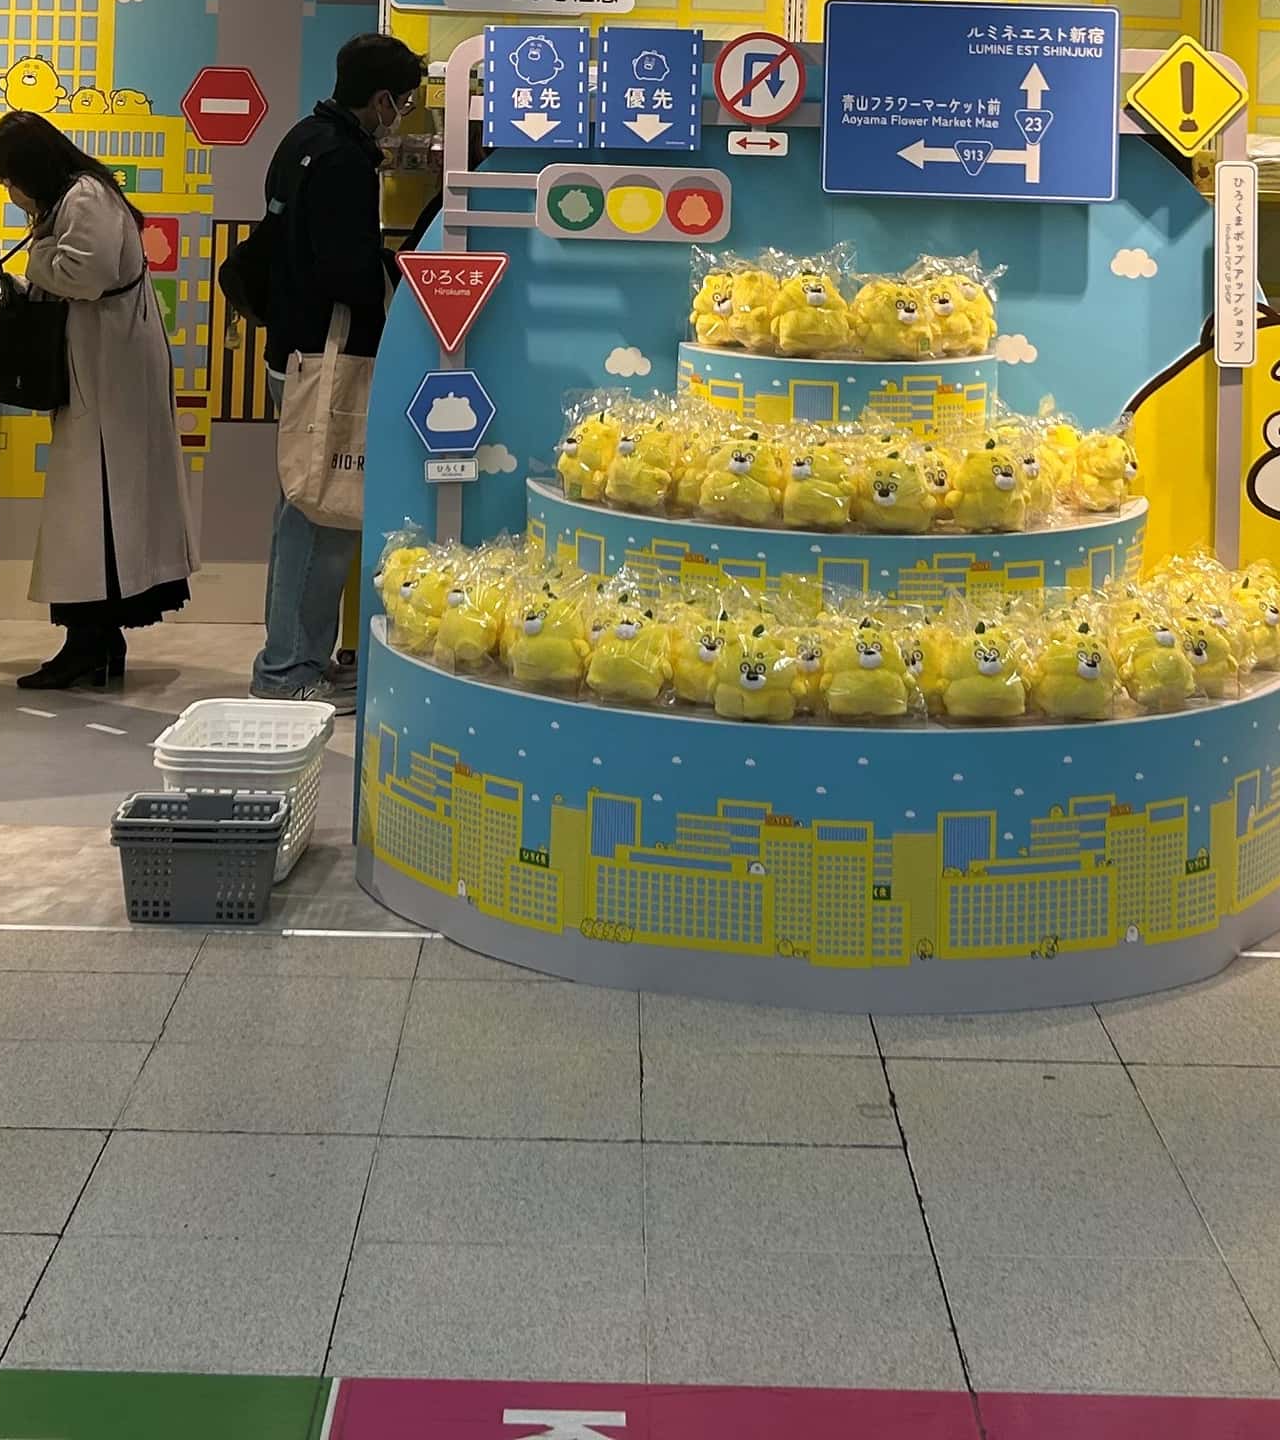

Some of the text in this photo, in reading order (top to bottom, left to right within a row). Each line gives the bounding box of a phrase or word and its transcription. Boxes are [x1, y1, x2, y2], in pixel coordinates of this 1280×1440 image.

[967, 25, 1105, 44] ルミネエスト新宿
[969, 44, 1102, 58] LUMINE EST SHINJUKU
[511, 88, 561, 109] 優先
[624, 88, 673, 110] 優先
[841, 94, 1001, 116] 青山フラワーマーケット前
[841, 113, 999, 128] Aoyama Flower Market Mae
[1025, 117, 1042, 131] 23
[963, 149, 983, 161] 913
[421, 269, 483, 286] ひろくま
